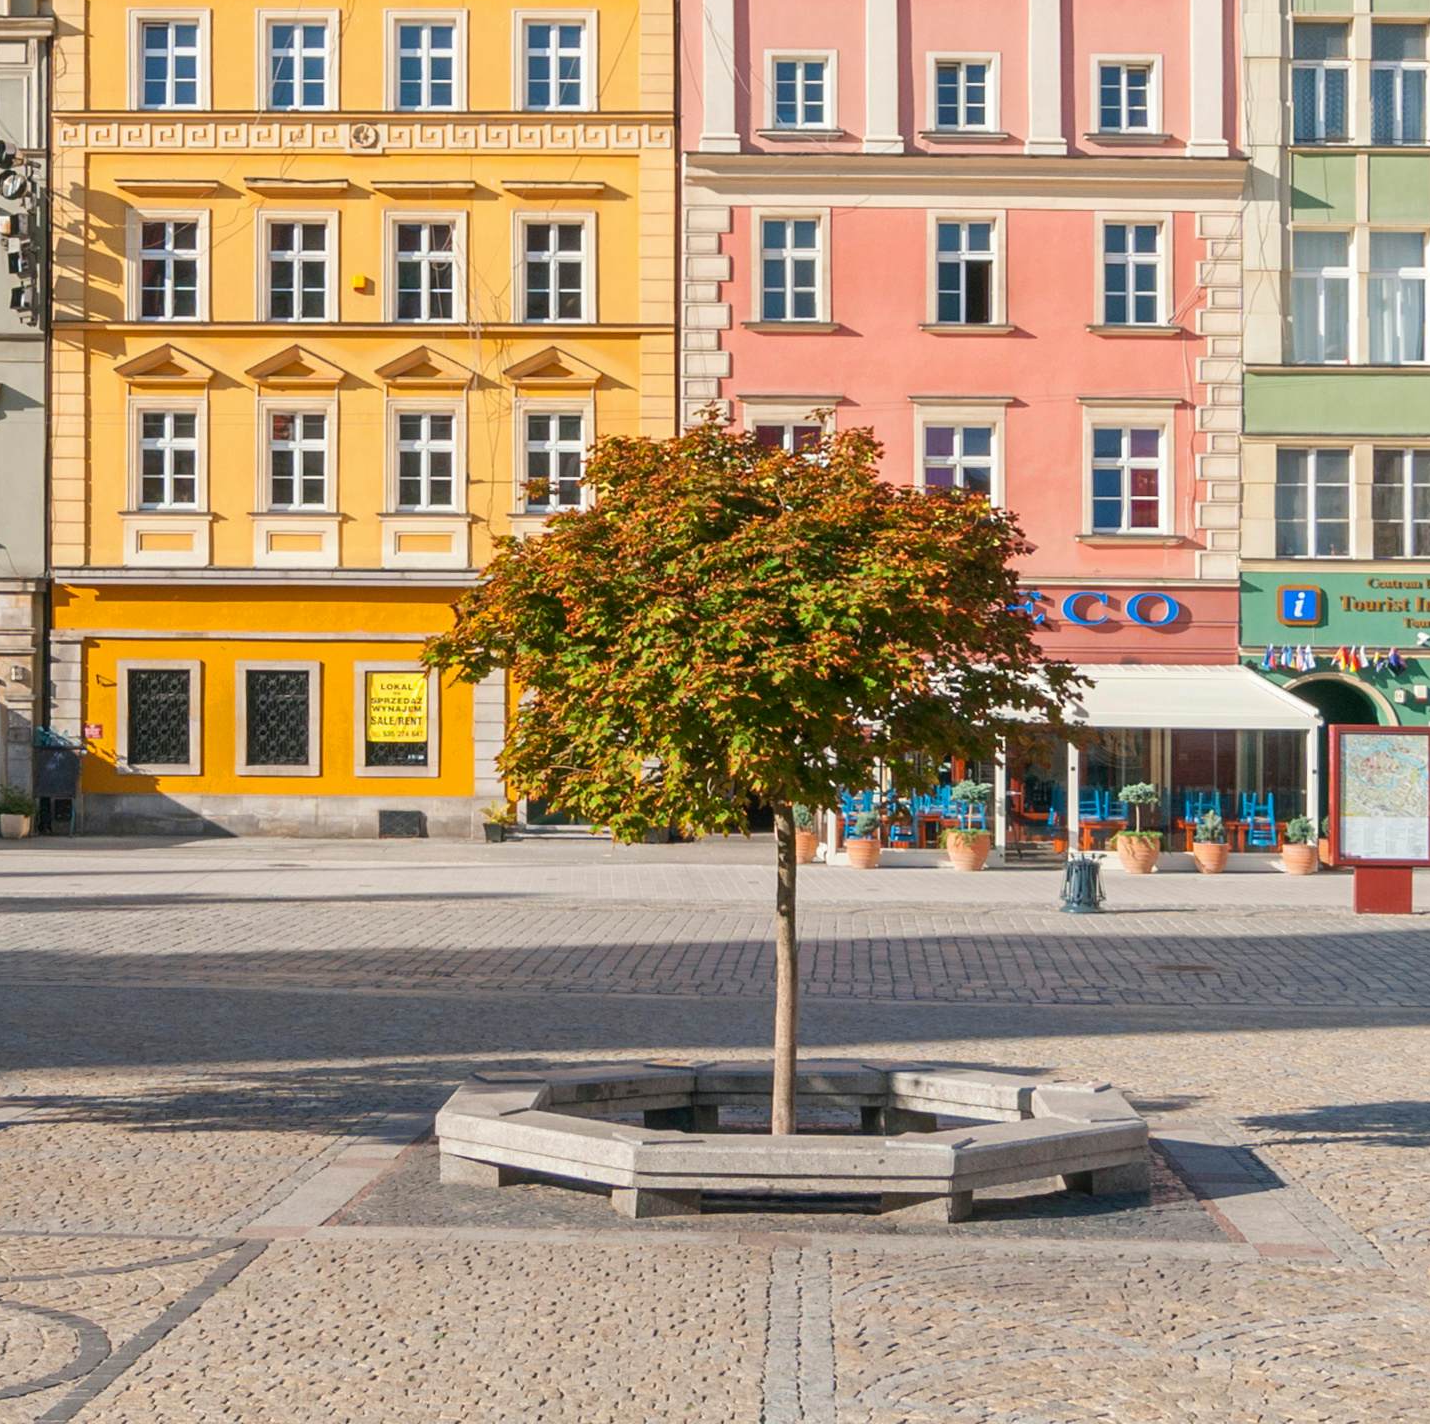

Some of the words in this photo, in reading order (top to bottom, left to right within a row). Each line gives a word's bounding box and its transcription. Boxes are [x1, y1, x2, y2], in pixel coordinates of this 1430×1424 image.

[1367, 577, 1423, 590] Centrum
[1340, 596, 1411, 613] Tourist
[380, 683, 413, 691] LOKAL
[371, 705, 422, 713] WYNAJEM
[370, 716, 422, 726] SALE/RENT
